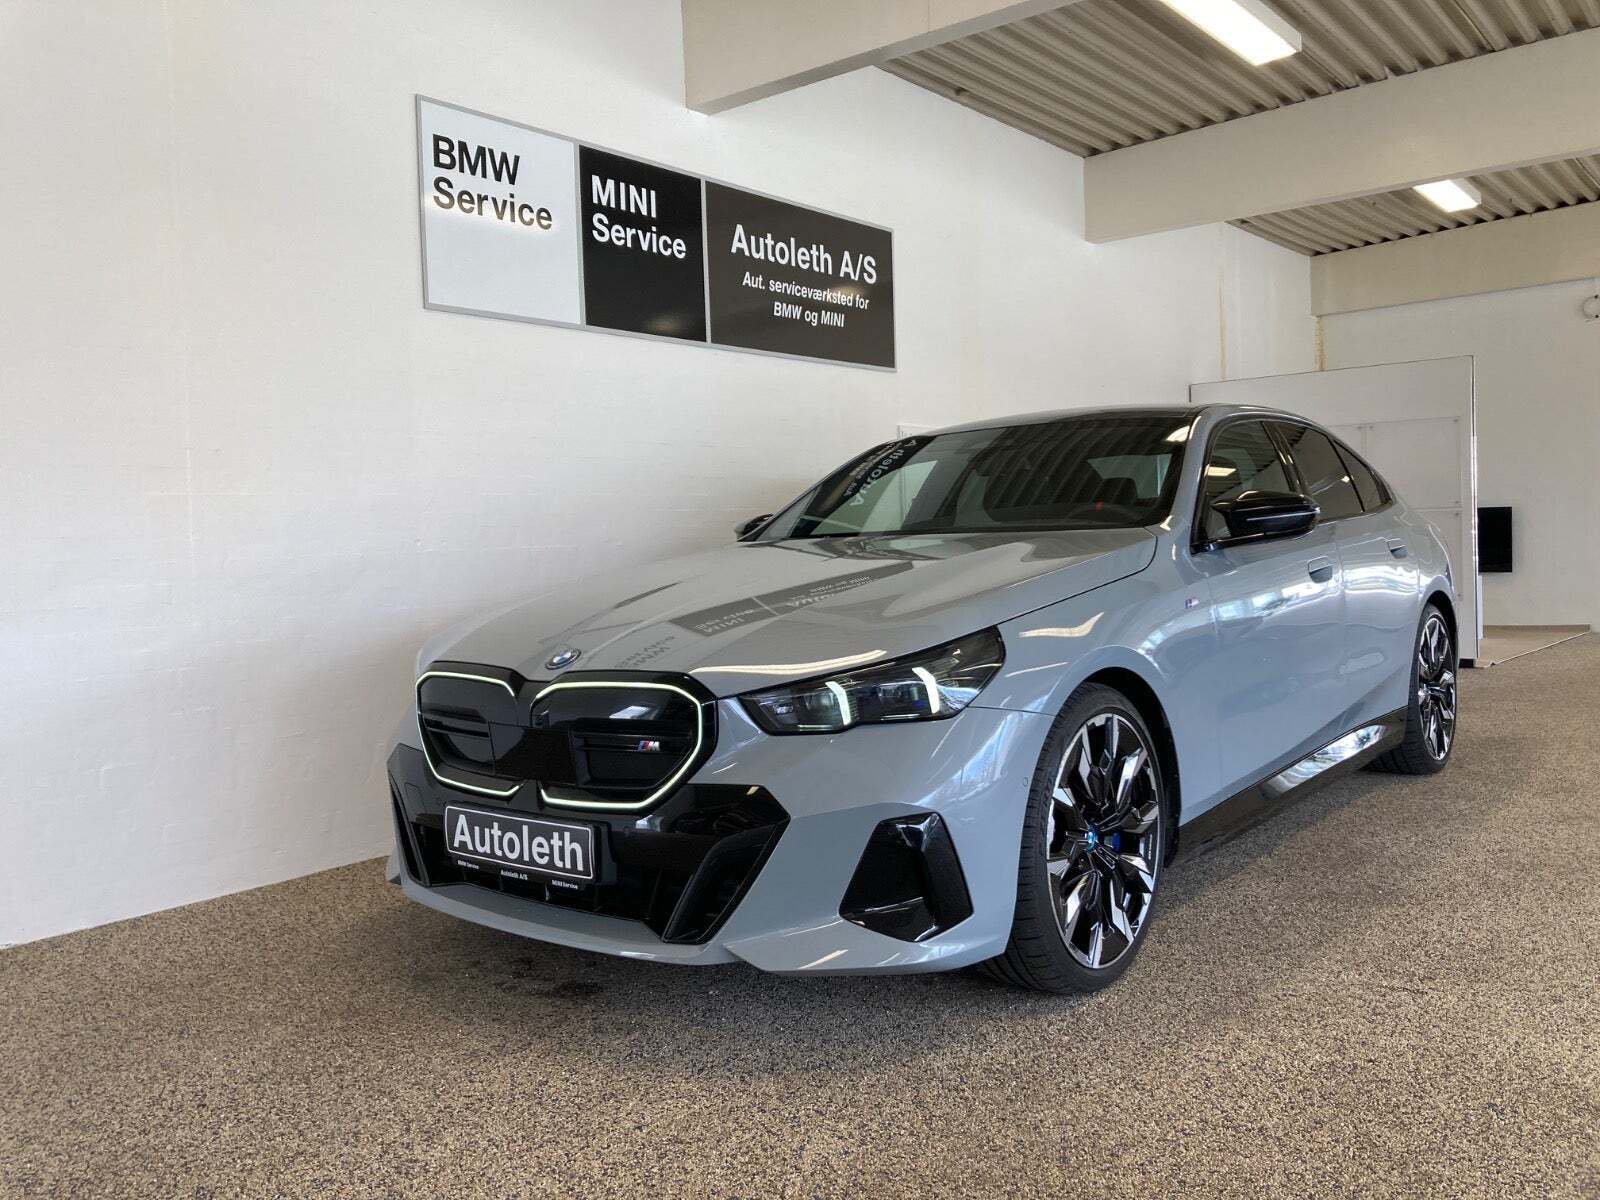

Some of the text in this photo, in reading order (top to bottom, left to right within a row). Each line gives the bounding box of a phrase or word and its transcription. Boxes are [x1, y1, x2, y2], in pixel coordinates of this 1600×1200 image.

[432, 134, 520, 185] BMW
[433, 176, 553, 230] Service
[591, 175, 657, 218] MINI
[592, 214, 687, 259] Service
[730, 224, 877, 285] Autoleth A/S
[742, 271, 870, 310] Aut. serviceværksted for
[773, 302, 845, 328] BMW og MINI
[453, 814, 583, 871] Autoleth
